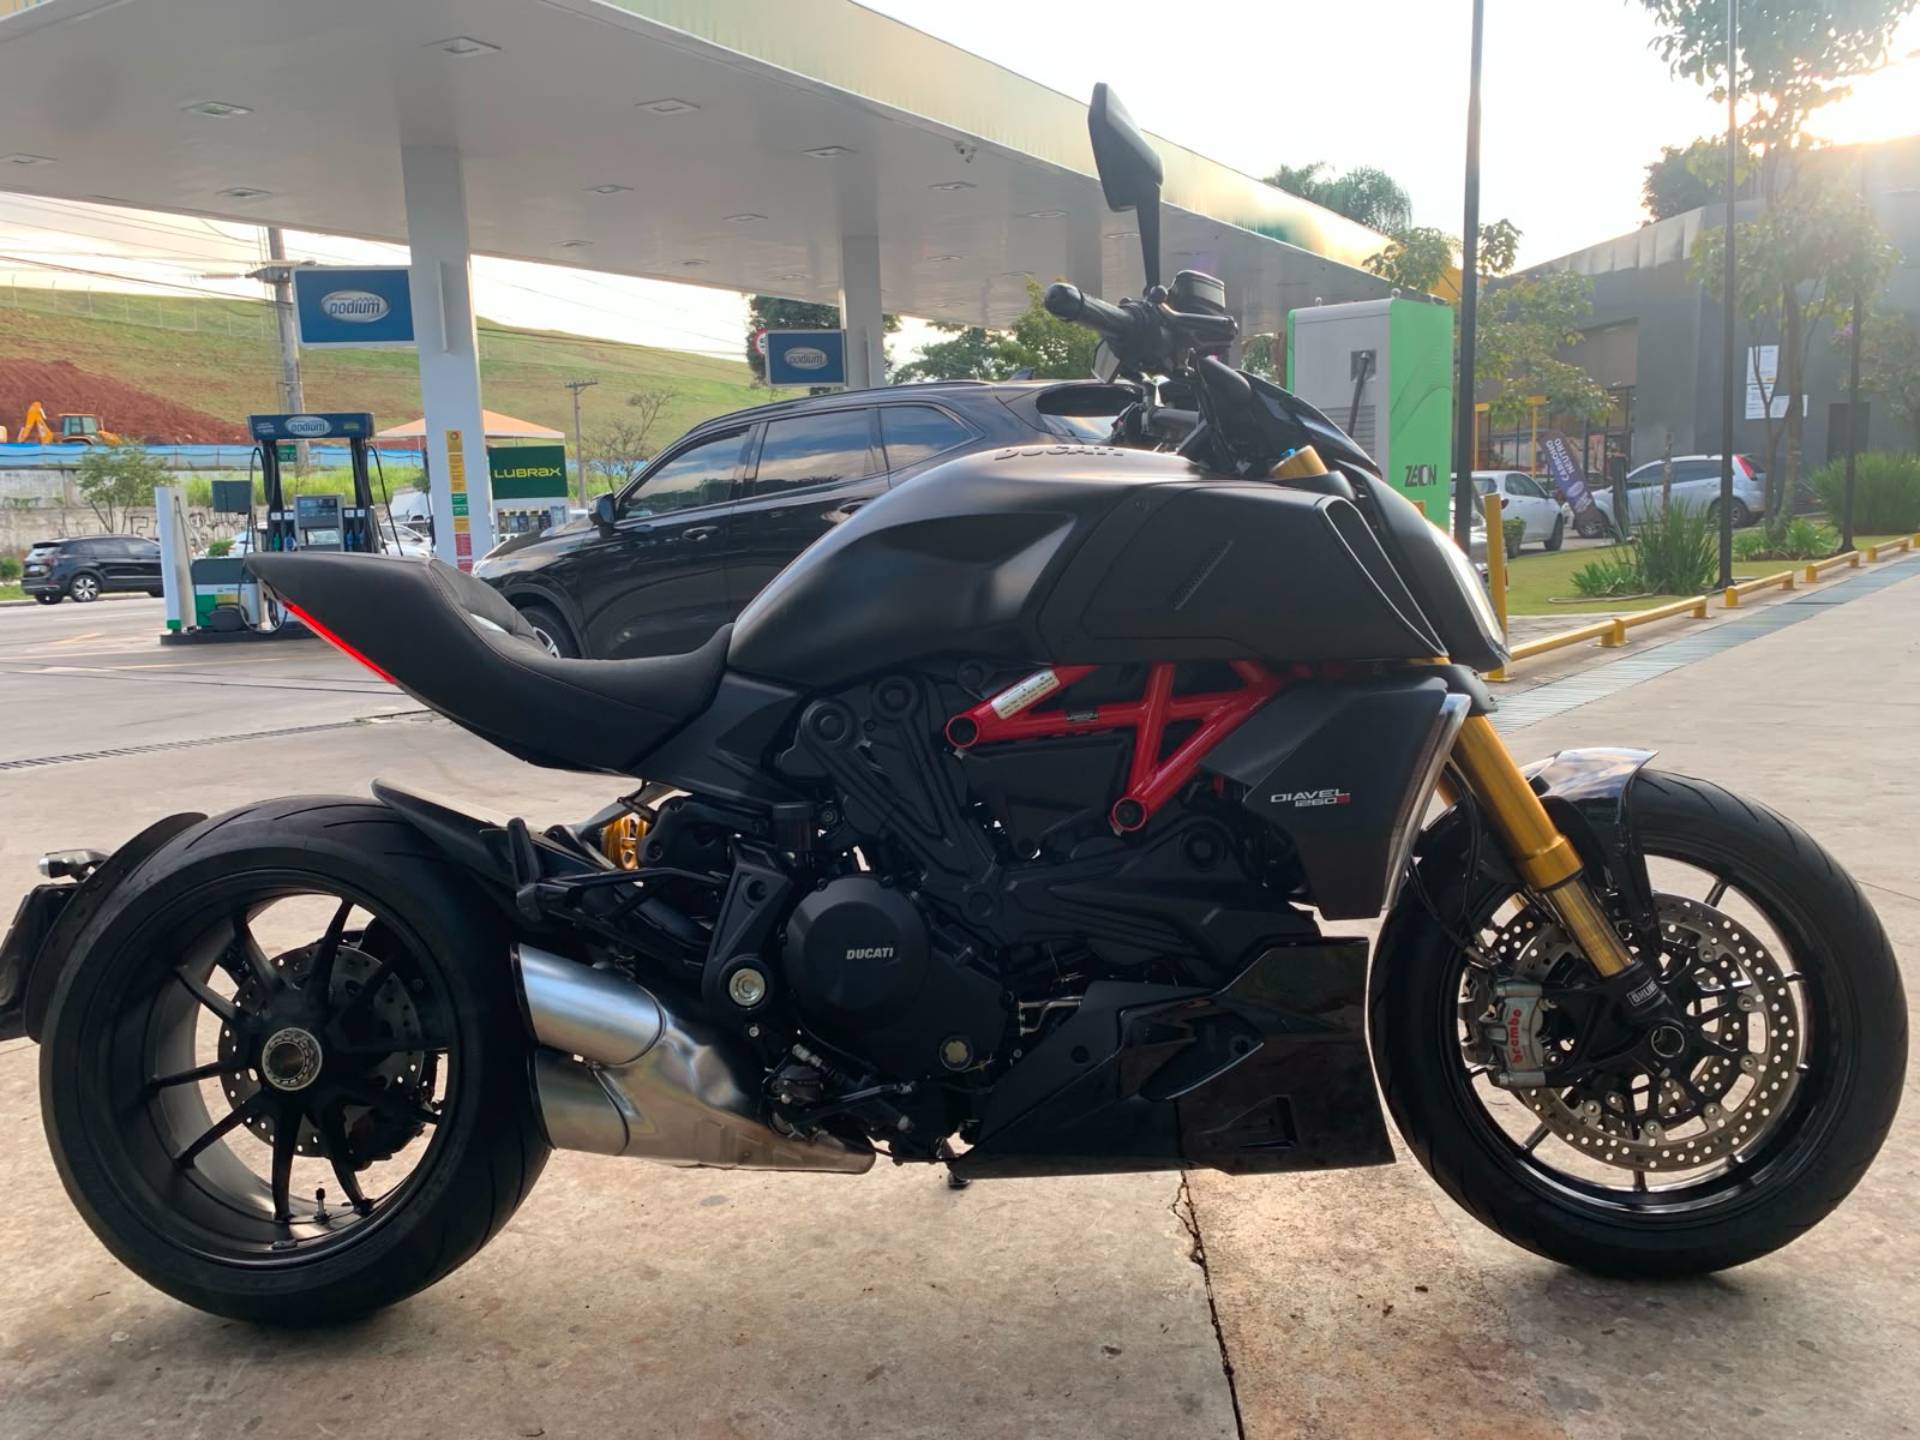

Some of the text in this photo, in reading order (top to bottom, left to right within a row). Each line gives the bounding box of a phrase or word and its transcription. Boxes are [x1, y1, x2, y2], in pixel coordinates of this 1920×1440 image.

[328, 301, 381, 316] podium
[1554, 438, 1576, 475] NEUTRO
[1270, 788, 1351, 803] DIAVEL
[846, 947, 894, 960] DUCATI
[1508, 1008, 1523, 1064] brembo
